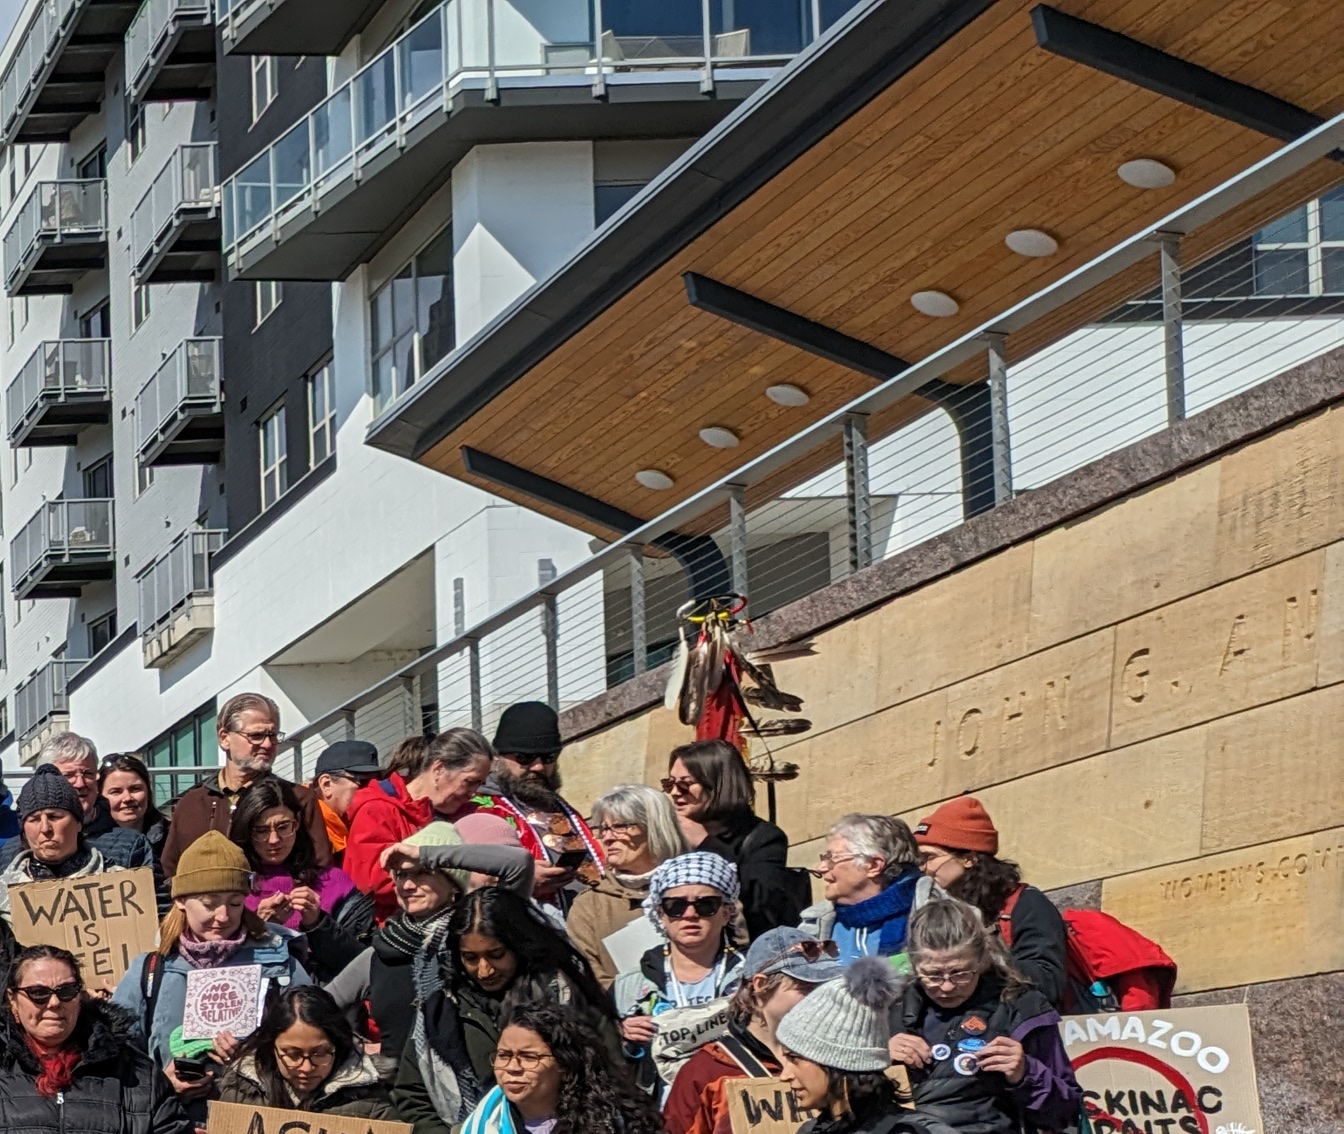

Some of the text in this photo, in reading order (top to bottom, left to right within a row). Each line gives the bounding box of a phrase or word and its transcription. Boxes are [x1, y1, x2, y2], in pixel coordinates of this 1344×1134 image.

[927, 674, 1072, 769] JOHN
[18, 879, 145, 926] WATER
[73, 923, 101, 948] IS
[200, 991, 239, 1003] MORE
[210, 982, 231, 992] NO
[199, 998, 243, 1011] STOLEN
[696, 1012, 728, 1035] LINE
